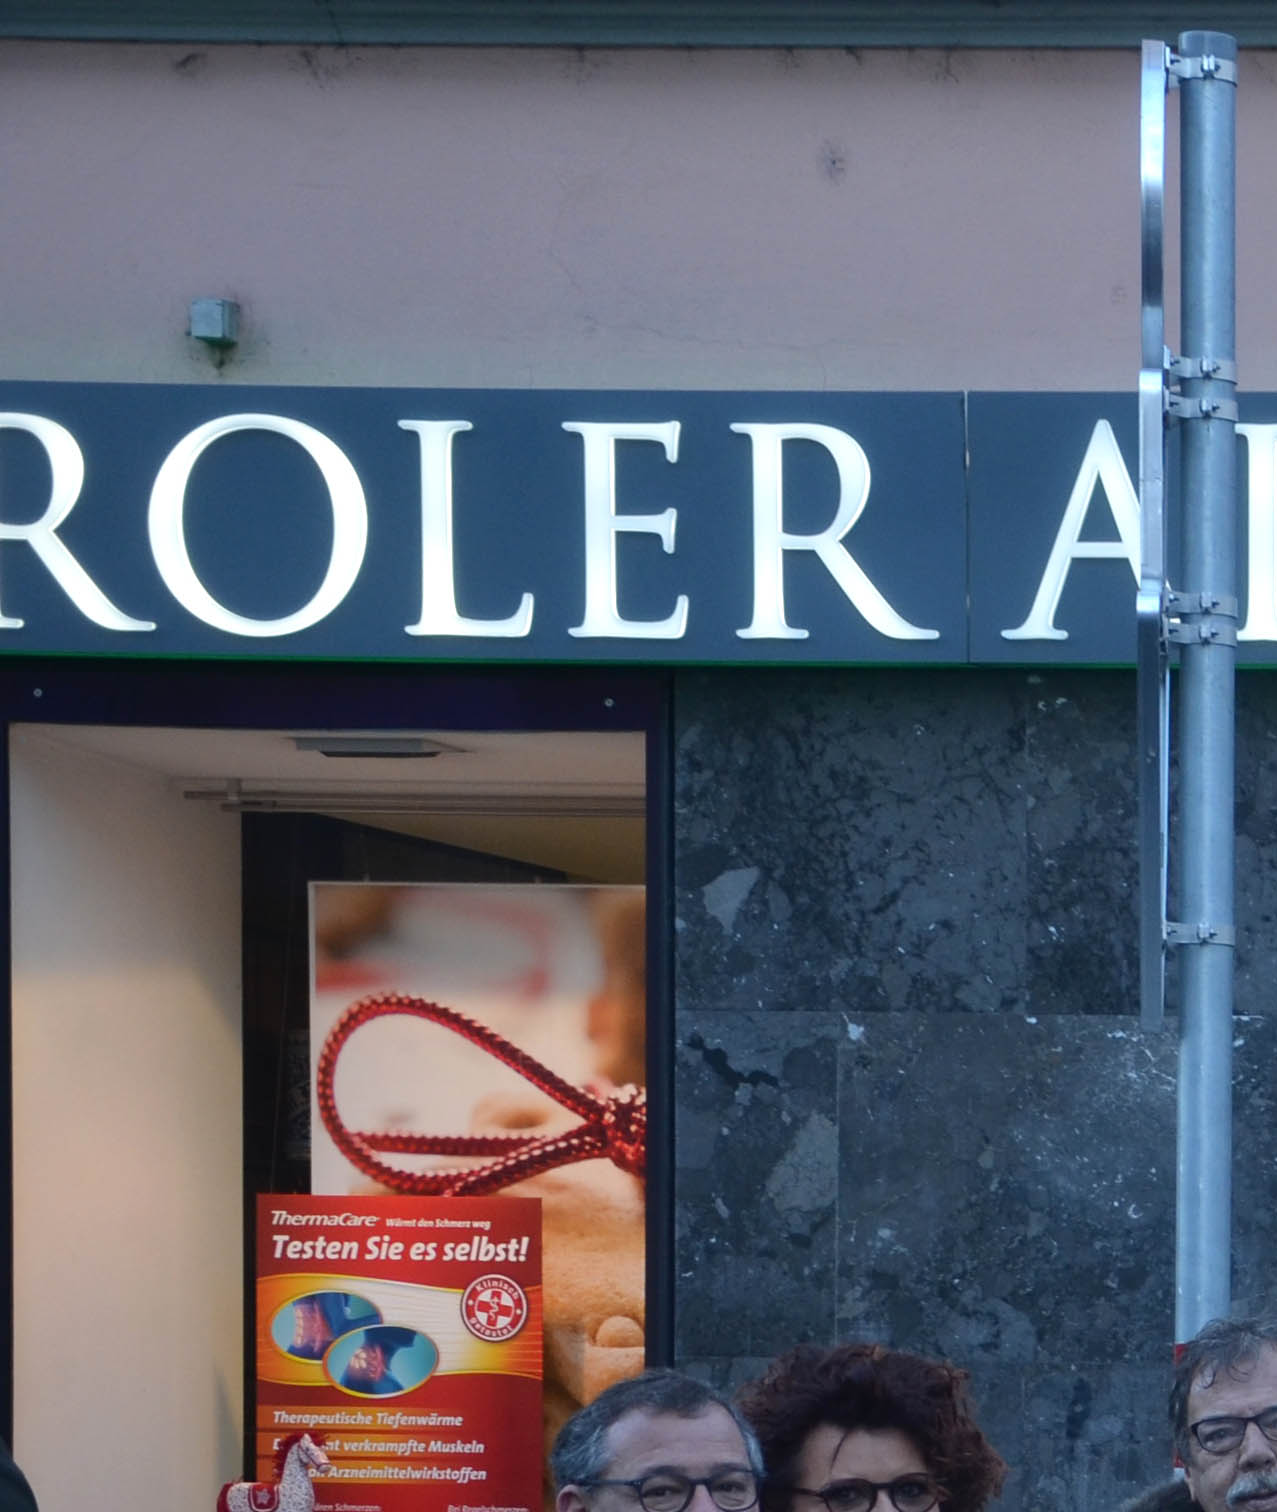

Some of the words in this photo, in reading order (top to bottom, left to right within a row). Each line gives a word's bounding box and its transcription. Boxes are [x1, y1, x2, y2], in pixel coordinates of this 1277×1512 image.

[0, 411, 940, 640] ROLER
[271, 1210, 377, 1227] ThermaCare
[272, 1235, 359, 1260] Testen
[364, 1235, 404, 1261] Sie
[409, 1241, 437, 1261] es
[442, 1235, 530, 1262] selbst!
[273, 1411, 372, 1426] Therapeutische
[376, 1413, 463, 1428] Tiefenwärme
[343, 1440, 425, 1455] verkrampfte
[428, 1441, 485, 1454] Muskeln
[328, 1467, 487, 1483] Arzneimittelwirkstoffen
